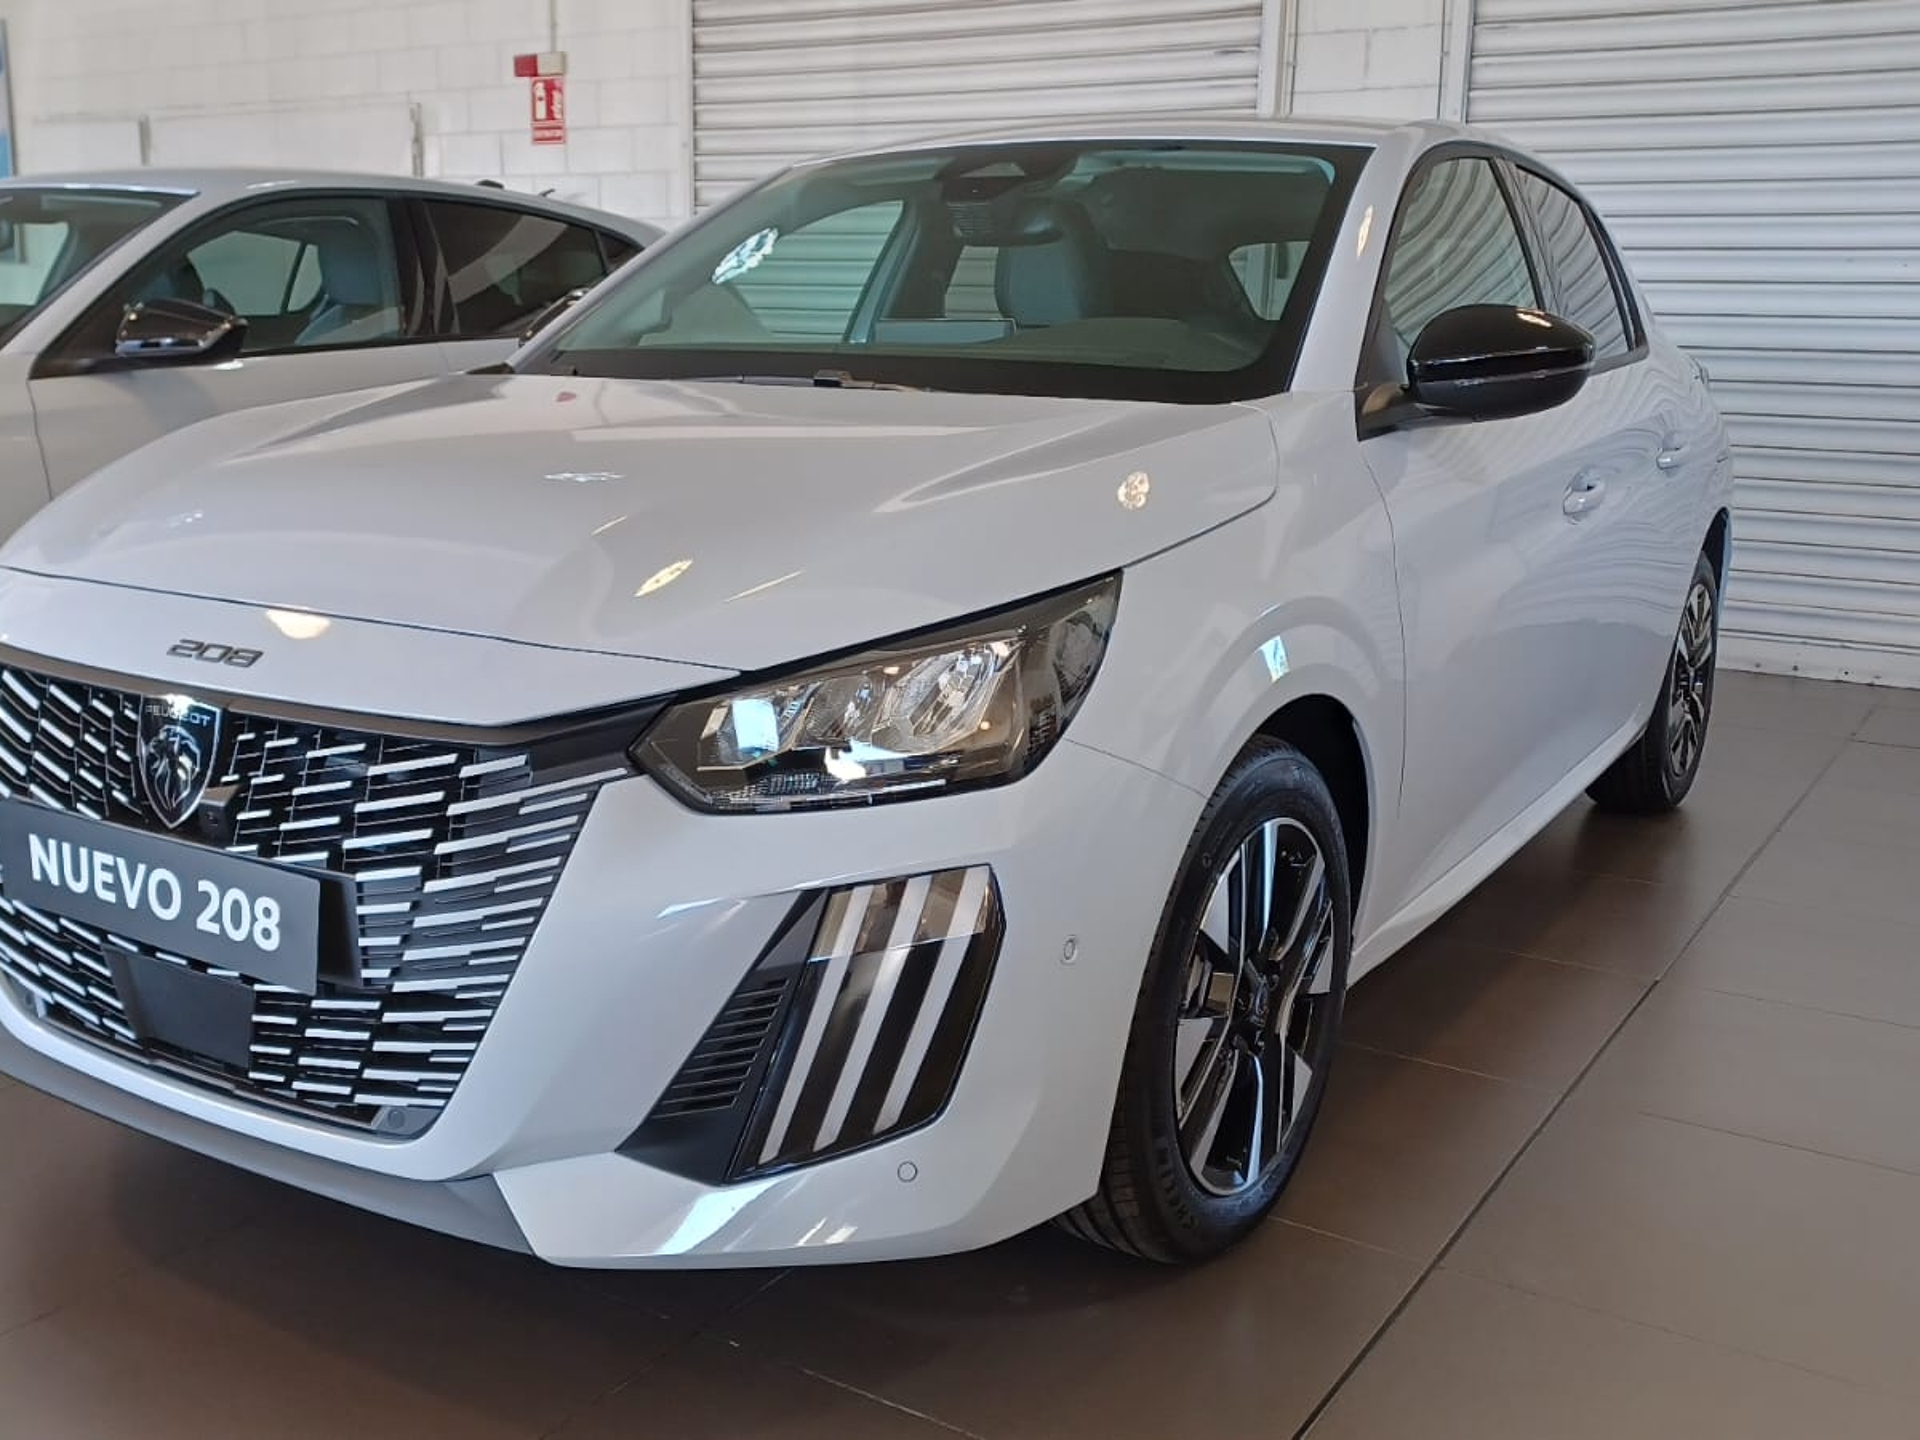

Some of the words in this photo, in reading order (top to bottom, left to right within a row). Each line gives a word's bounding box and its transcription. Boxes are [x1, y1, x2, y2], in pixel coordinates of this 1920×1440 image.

[166, 638, 264, 668] 208
[28, 833, 182, 921] NUEVO
[196, 879, 281, 951] 208
